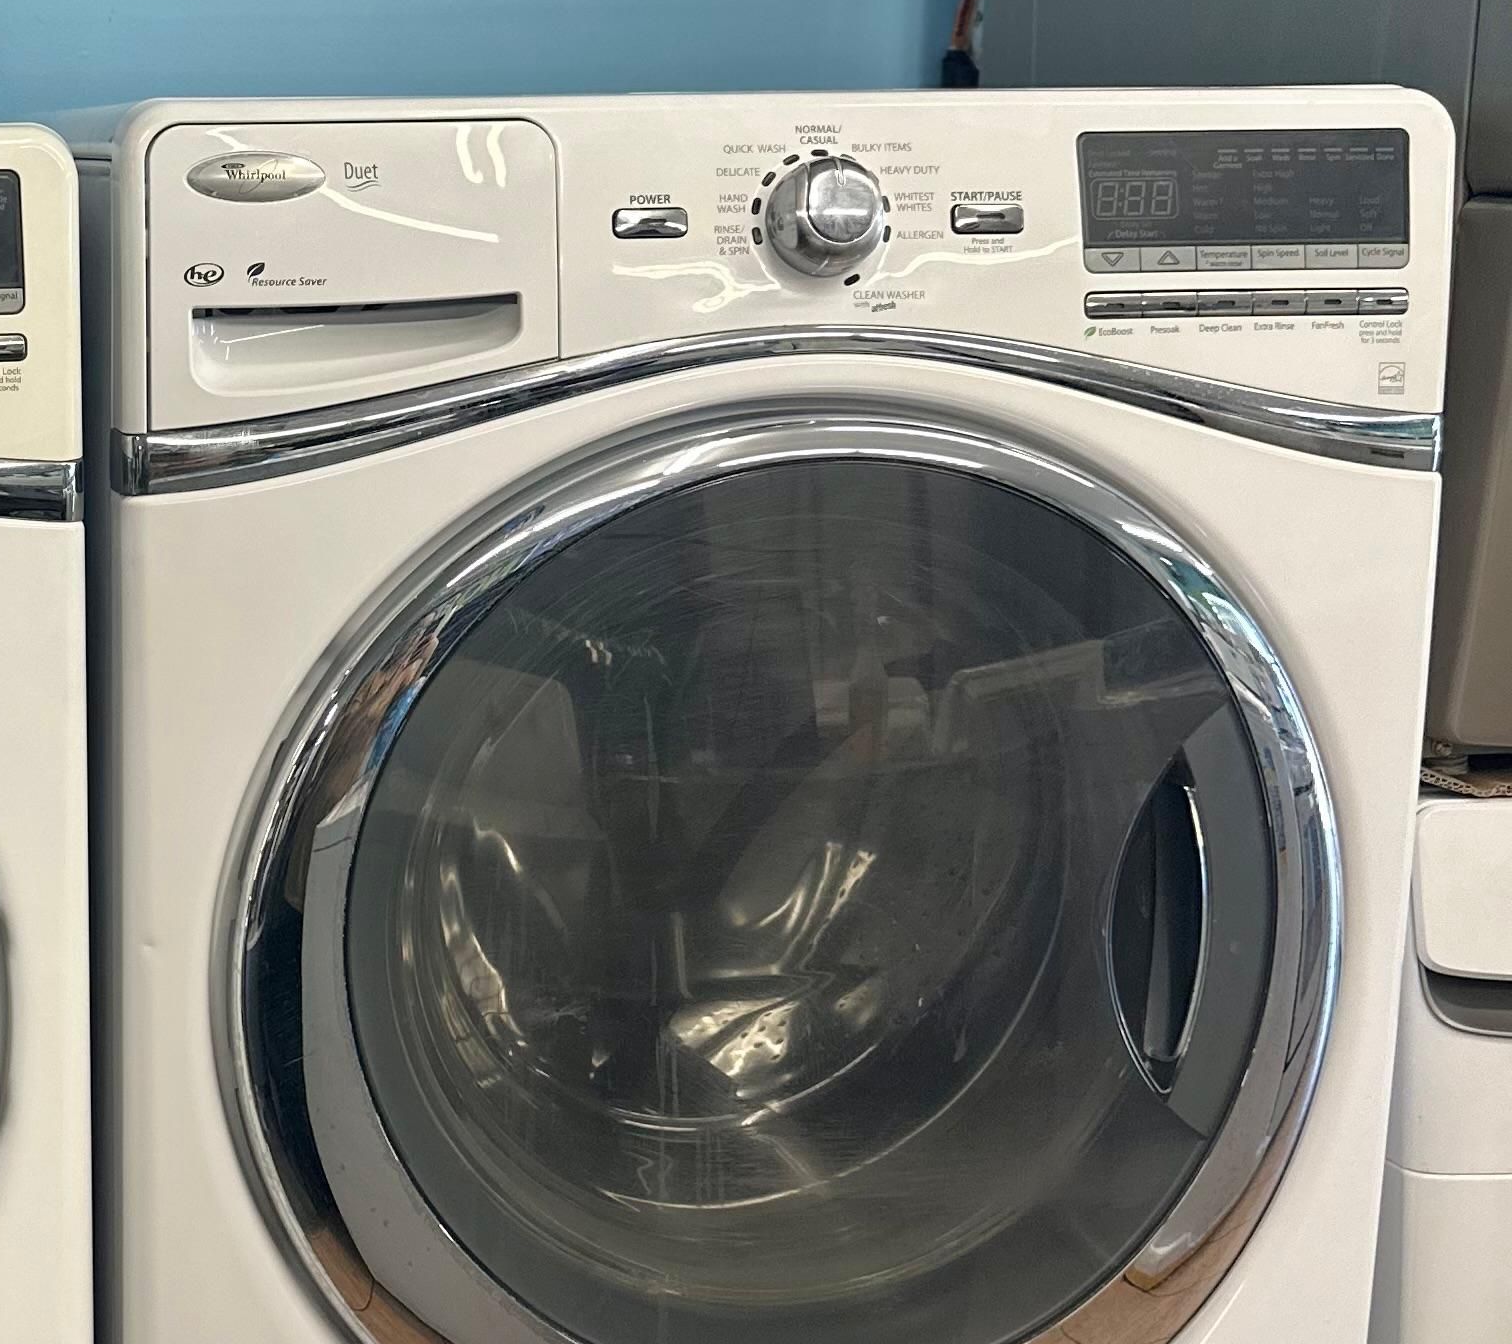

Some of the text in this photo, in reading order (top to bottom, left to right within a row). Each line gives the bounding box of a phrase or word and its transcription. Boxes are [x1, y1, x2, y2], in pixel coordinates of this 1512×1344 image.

[794, 124, 842, 134] NORMAL/
[799, 135, 839, 145] CASUAL
[723, 143, 786, 154] QUICK WASH
[851, 142, 912, 153] BULKY ITEMS
[343, 161, 379, 180] Duet
[716, 166, 760, 177] DELICATE
[879, 165, 940, 175] HEAVY DUTY
[226, 168, 287, 183] Whirlpool
[629, 194, 671, 205] POWER
[719, 193, 748, 203] HAND
[894, 191, 935, 201] WHITEST
[951, 191, 1023, 202] START/PAUSE
[717, 203, 746, 214] WASH
[896, 202, 933, 212] WHITES
[716, 235, 747, 244] DRAIN
[896, 230, 944, 240] ALLERGEN
[719, 246, 750, 256] & SPIN
[1200, 249, 1248, 259] Temperature
[1257, 248, 1299, 258] Spin Speed
[1314, 248, 1348, 257] Soil Level
[1361, 247, 1404, 256] Cycle Signal
[251, 276, 327, 287] Resource Saver
[853, 290, 926, 299] CLEAN WASHER
[1199, 323, 1242, 334] Deep Clean
[1254, 322, 1295, 331] Extra Rinse
[1359, 319, 1402, 328] Control Lock
[1098, 327, 1133, 336] EcoBoost
[1150, 325, 1180, 334] Presoak
[3, 367, 22, 376] Lock
[5, 375, 22, 384] hold
